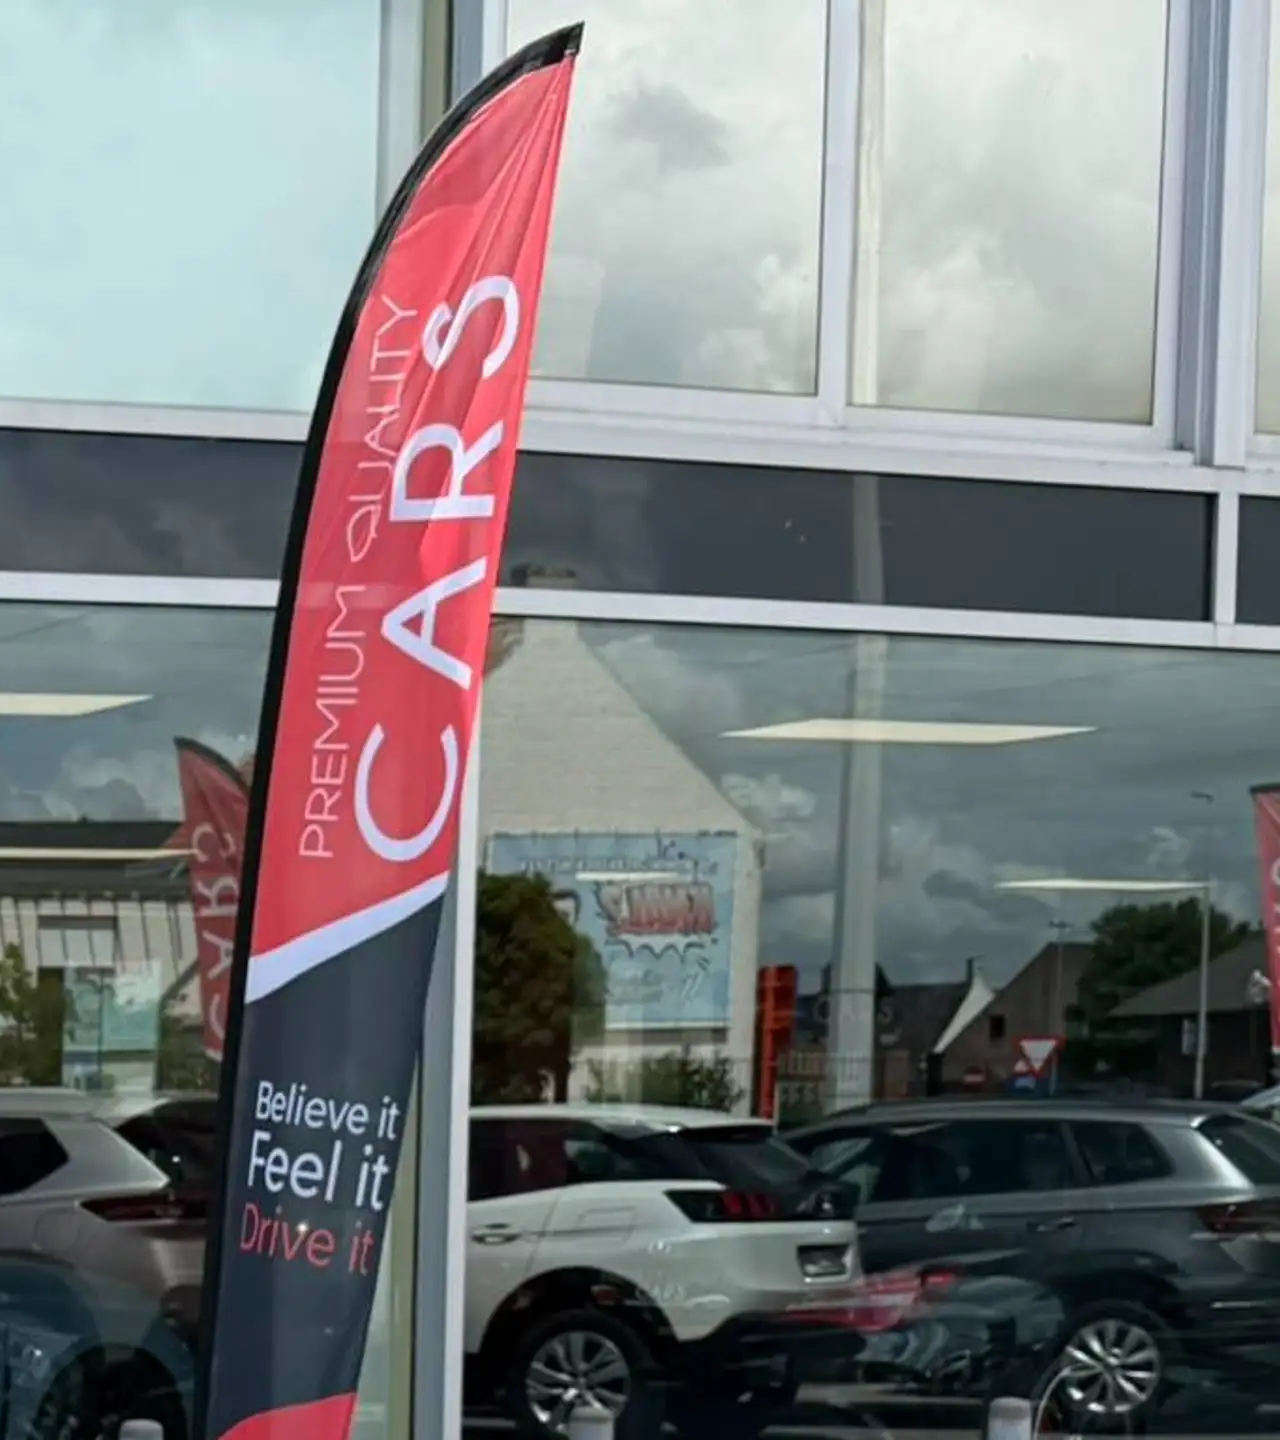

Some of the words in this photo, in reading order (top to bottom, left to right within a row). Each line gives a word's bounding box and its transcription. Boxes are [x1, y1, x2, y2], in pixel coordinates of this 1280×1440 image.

[299, 584, 367, 858] PREMIUM
[348, 294, 419, 563] QUALITY
[353, 272, 521, 864] CARS
[256, 1080, 370, 1135] Believe
[377, 1095, 399, 1141] it
[247, 1129, 342, 1203] Feel
[355, 1144, 391, 1211] it
[240, 1203, 336, 1267] Drive
[347, 1221, 374, 1277] it
